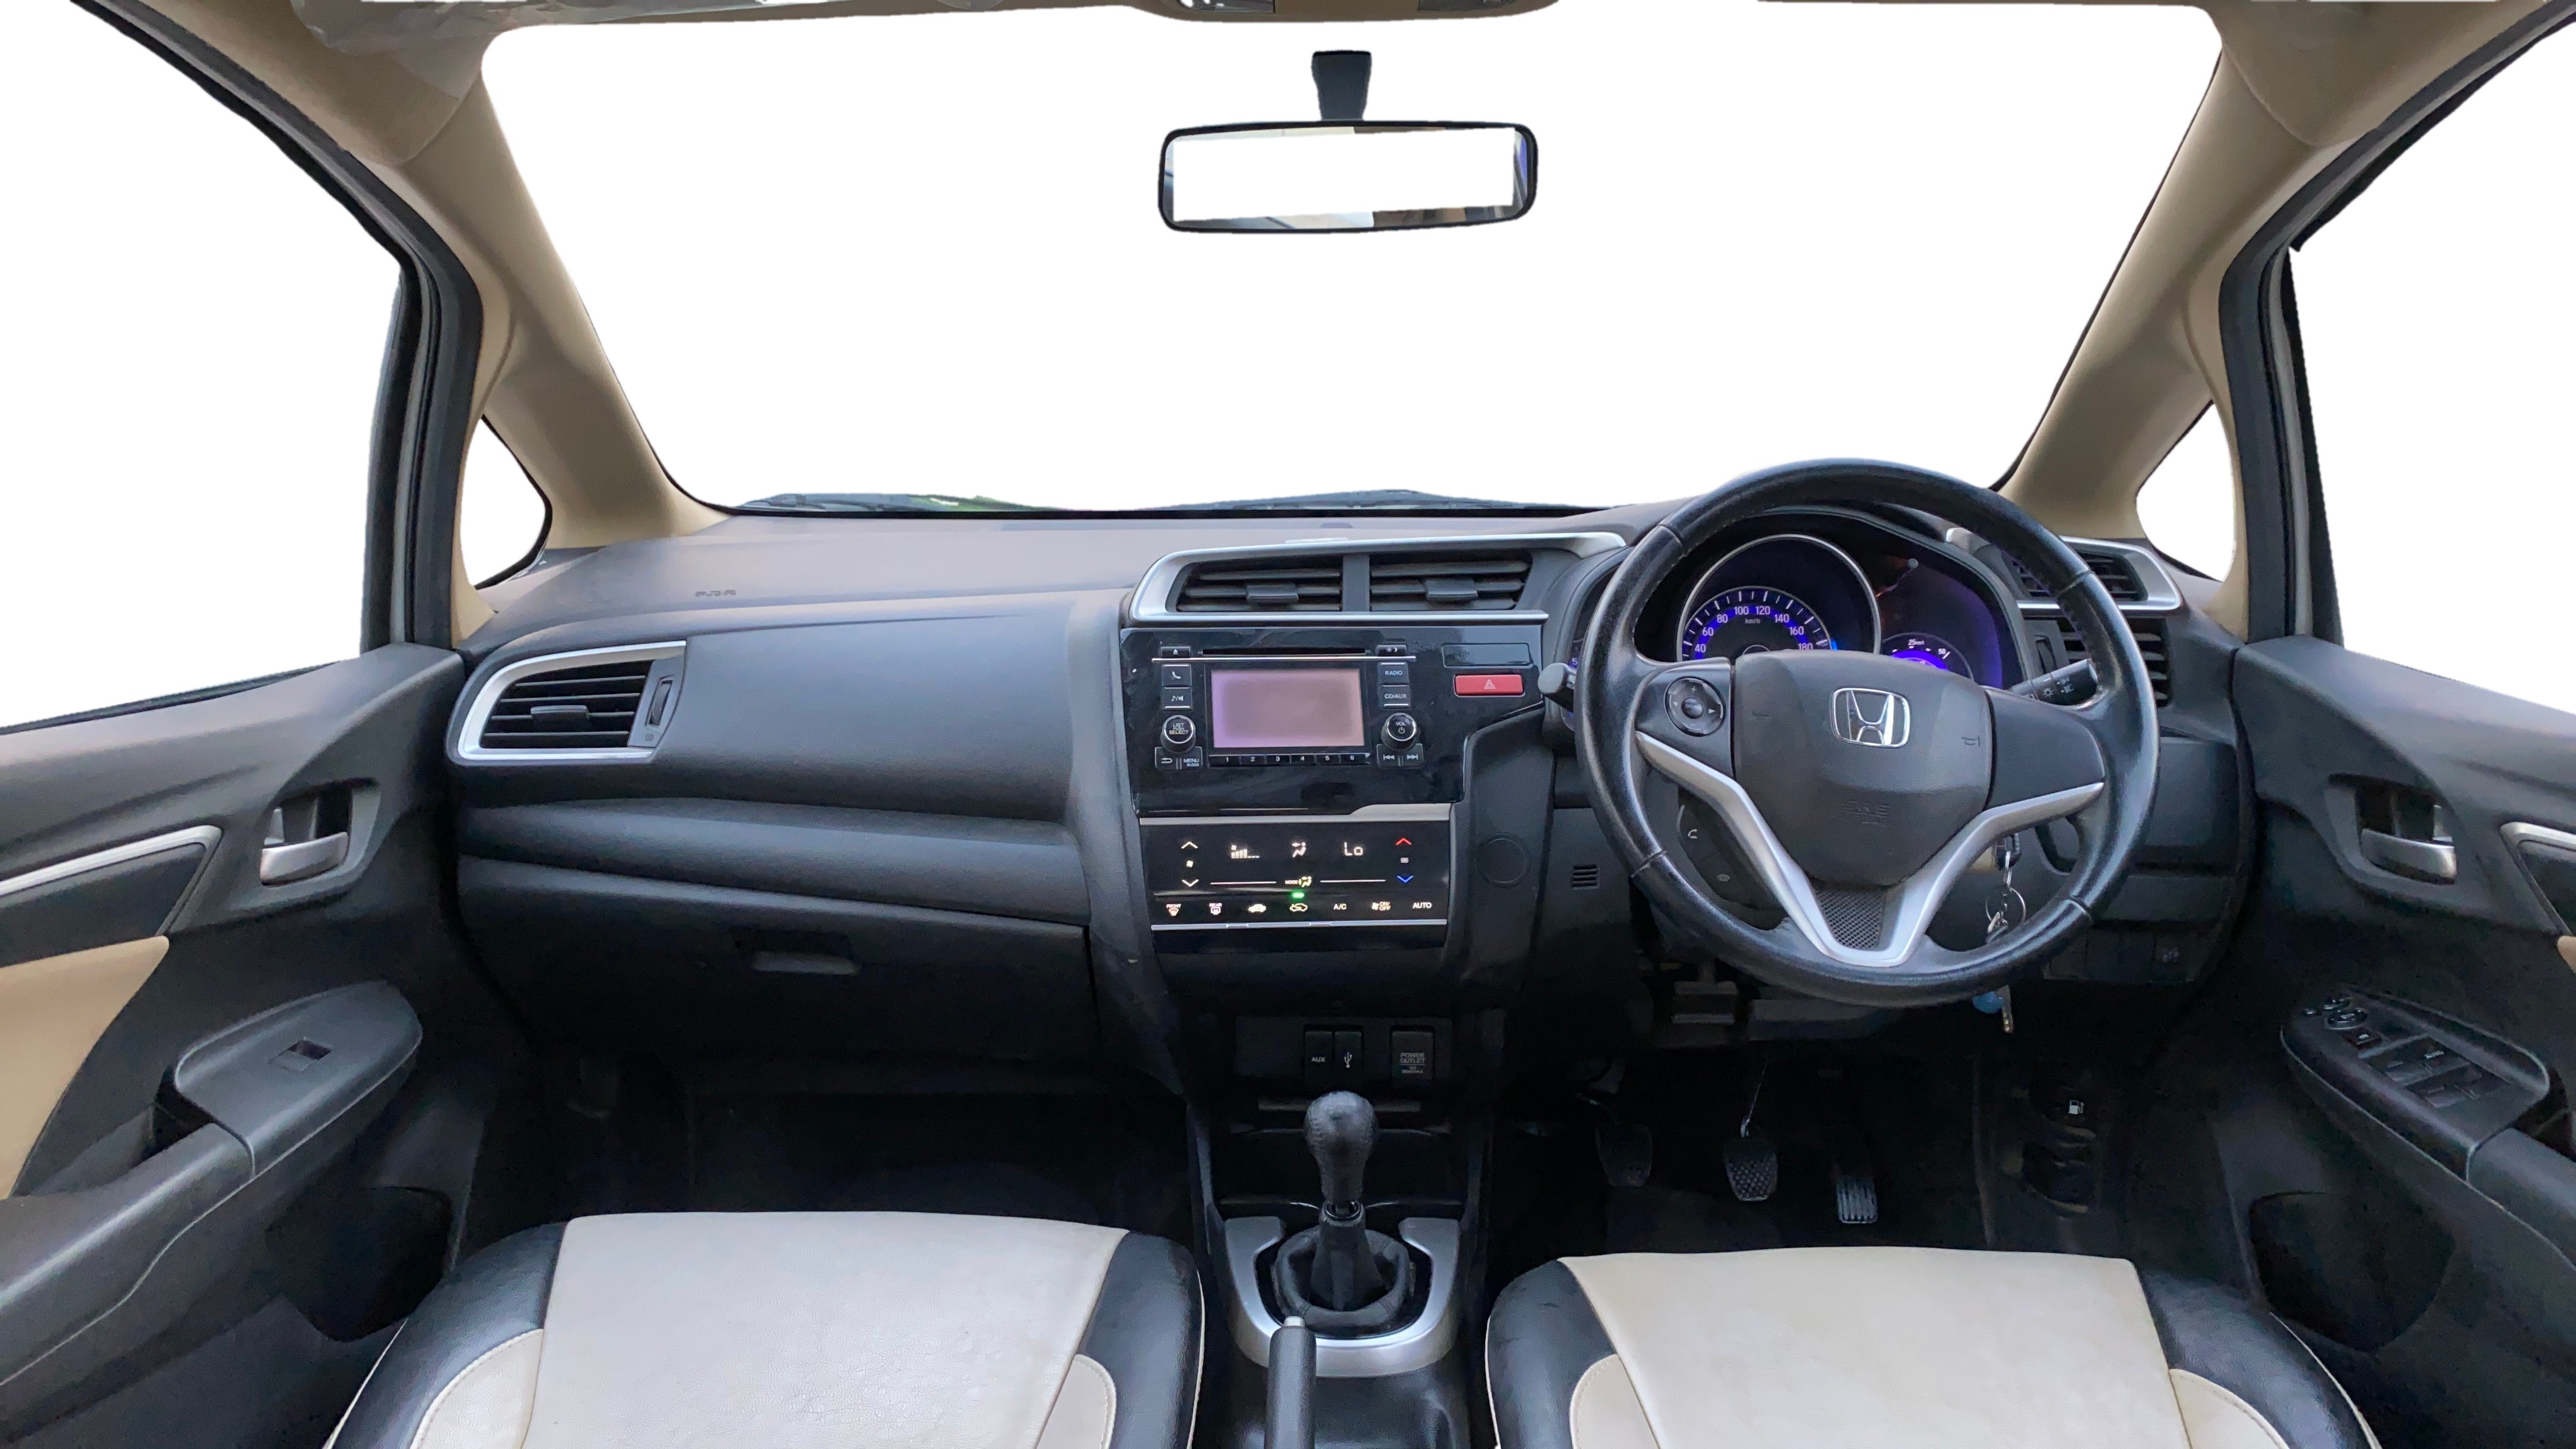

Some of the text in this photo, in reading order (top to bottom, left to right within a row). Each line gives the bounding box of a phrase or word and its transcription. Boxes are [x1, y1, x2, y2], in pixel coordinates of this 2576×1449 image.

[1734, 606, 1749, 615] 100
[1755, 606, 1771, 615] 120
[1716, 614, 1728, 623] 80
[1775, 614, 1790, 623] 140
[1702, 627, 1714, 636] 60
[1789, 626, 1805, 635] 160
[1694, 643, 1706, 653] 40
